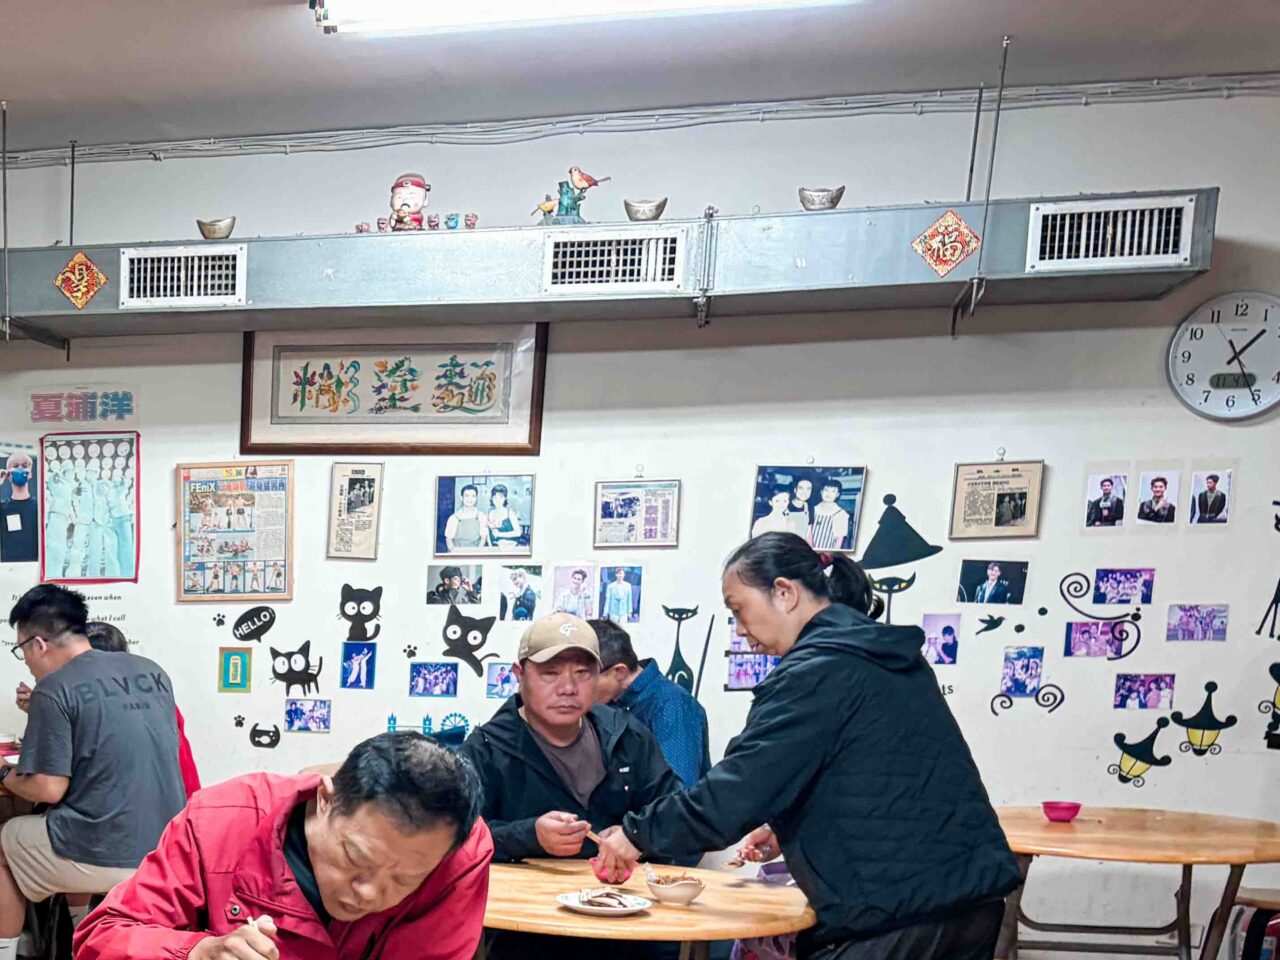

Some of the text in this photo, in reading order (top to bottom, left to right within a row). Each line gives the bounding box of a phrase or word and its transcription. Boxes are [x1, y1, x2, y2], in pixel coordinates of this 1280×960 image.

[1210, 310, 1221, 324] 11
[1234, 303, 1249, 317] 12
[1263, 308, 1269, 322] 1
[1189, 327, 1205, 341] 10
[1181, 350, 1192, 364] 9
[1185, 373, 1196, 386] 8
[1202, 389, 1212, 403] 7
[1225, 395, 1236, 409] 6
[30, 390, 135, 423] 夏浦洋
[233, 608, 275, 638] HELLO!
[76, 671, 169, 704] BLVCK
